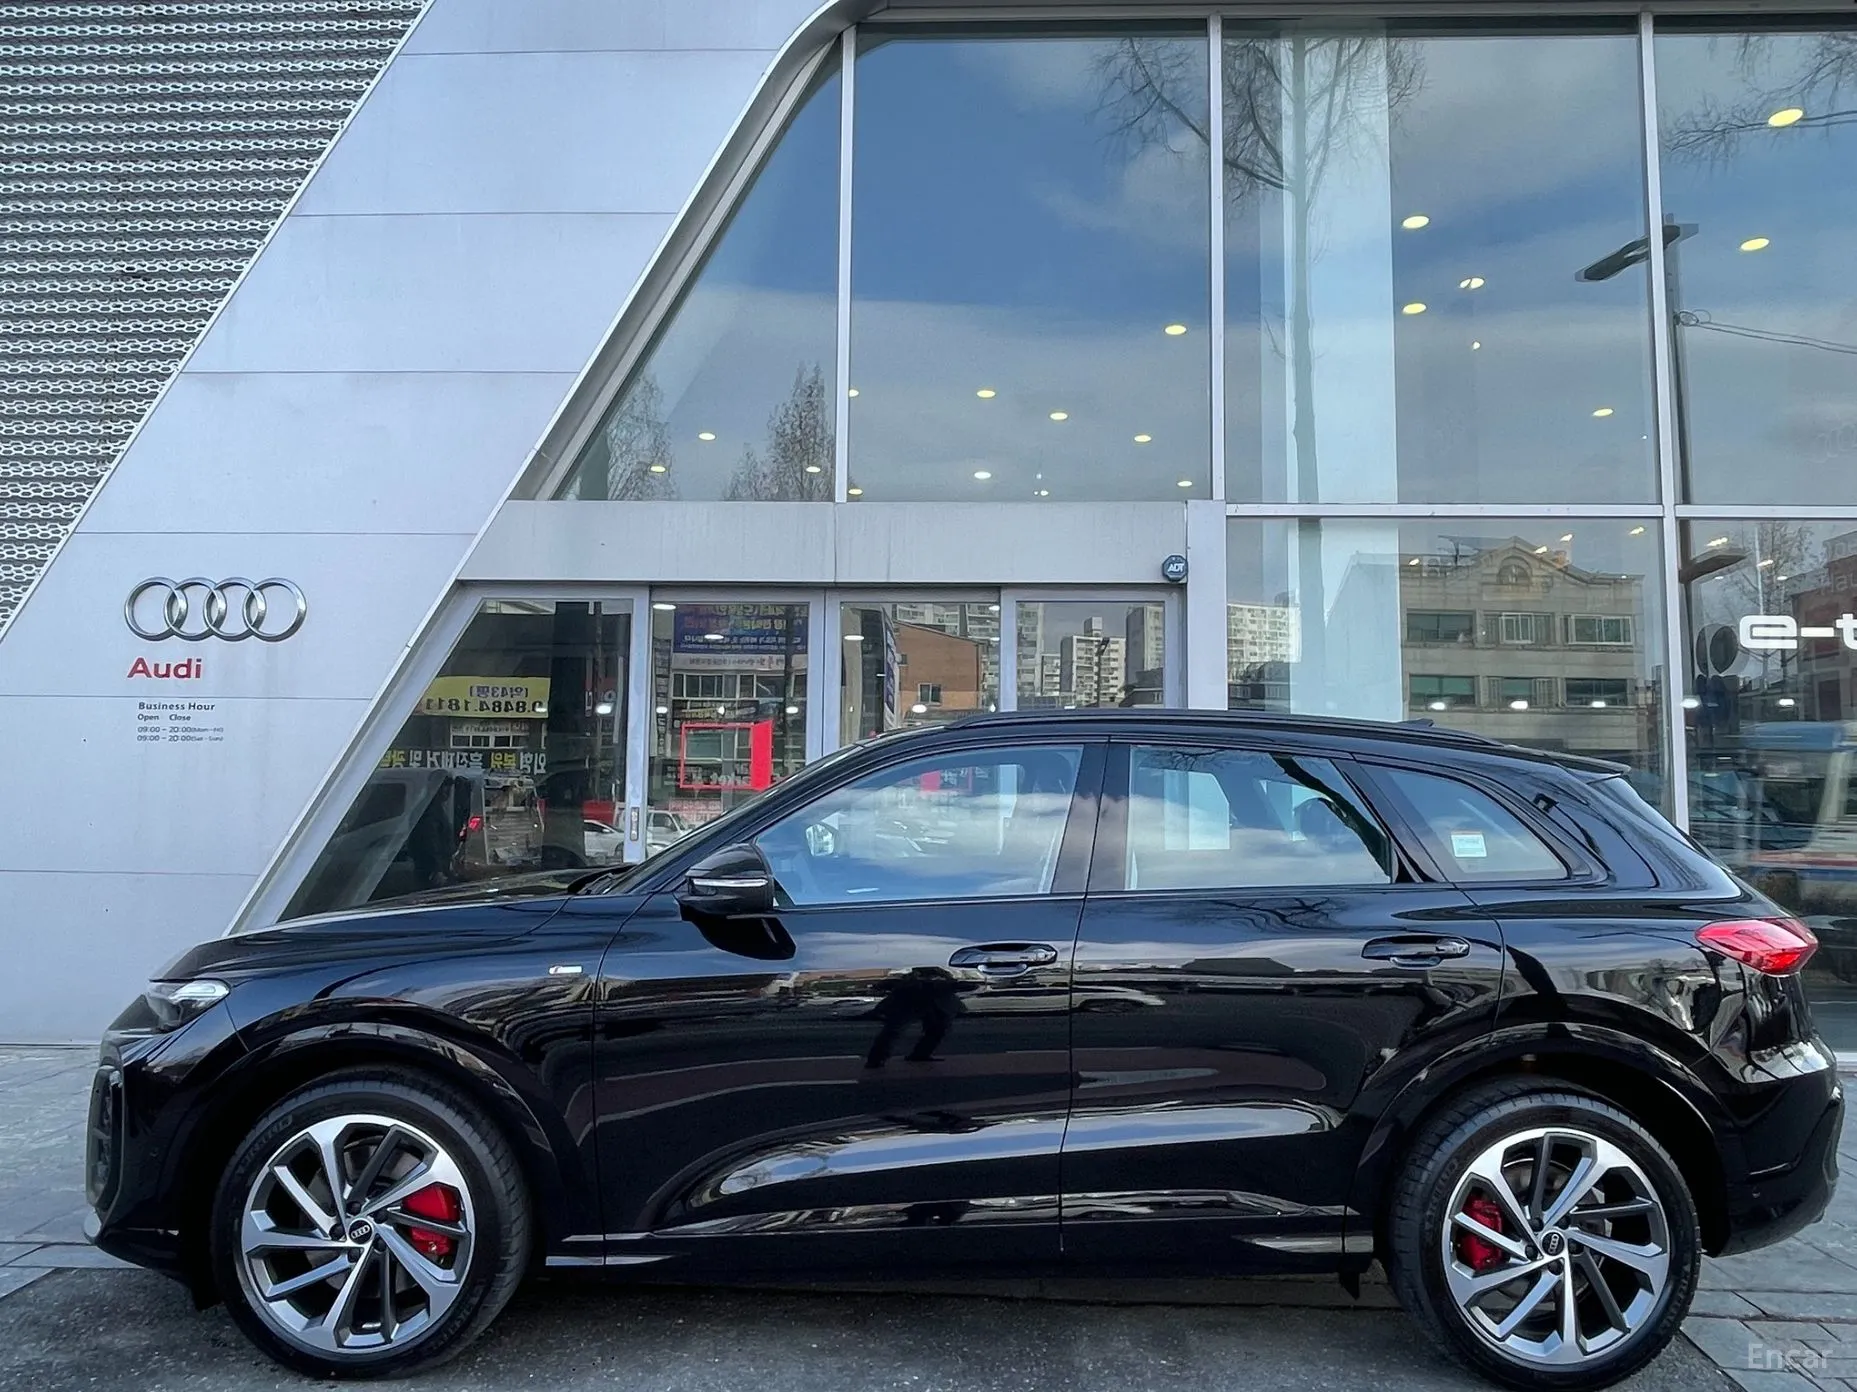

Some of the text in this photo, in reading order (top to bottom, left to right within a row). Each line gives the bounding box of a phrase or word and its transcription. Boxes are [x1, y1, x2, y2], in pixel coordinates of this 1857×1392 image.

[1168, 563, 1184, 572] ADT
[127, 657, 202, 679] Audi
[138, 701, 216, 711] Business Hour
[137, 713, 192, 722] Open Close
